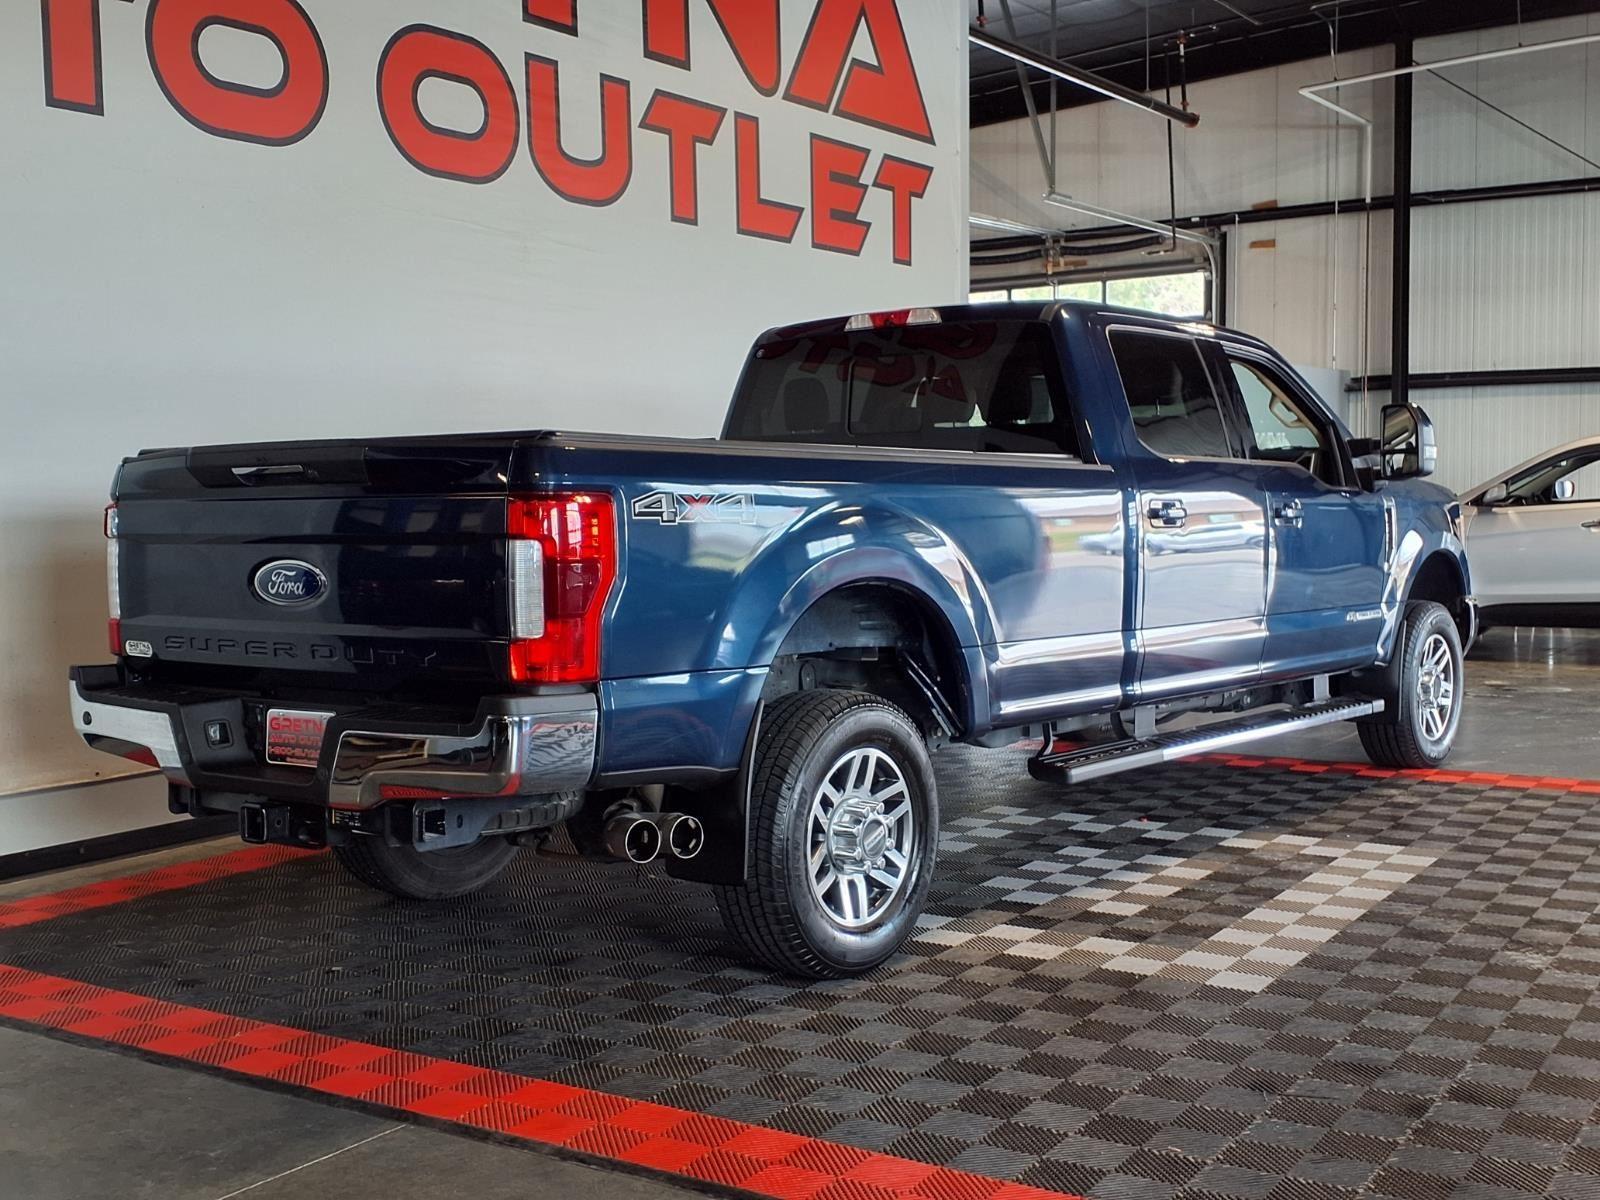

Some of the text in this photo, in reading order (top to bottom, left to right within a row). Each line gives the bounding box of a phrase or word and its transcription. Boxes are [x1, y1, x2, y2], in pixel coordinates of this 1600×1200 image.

[376, 23, 934, 266] OUTLET
[268, 569, 306, 595] Ford
[164, 634, 437, 667] SUPER DUTY
